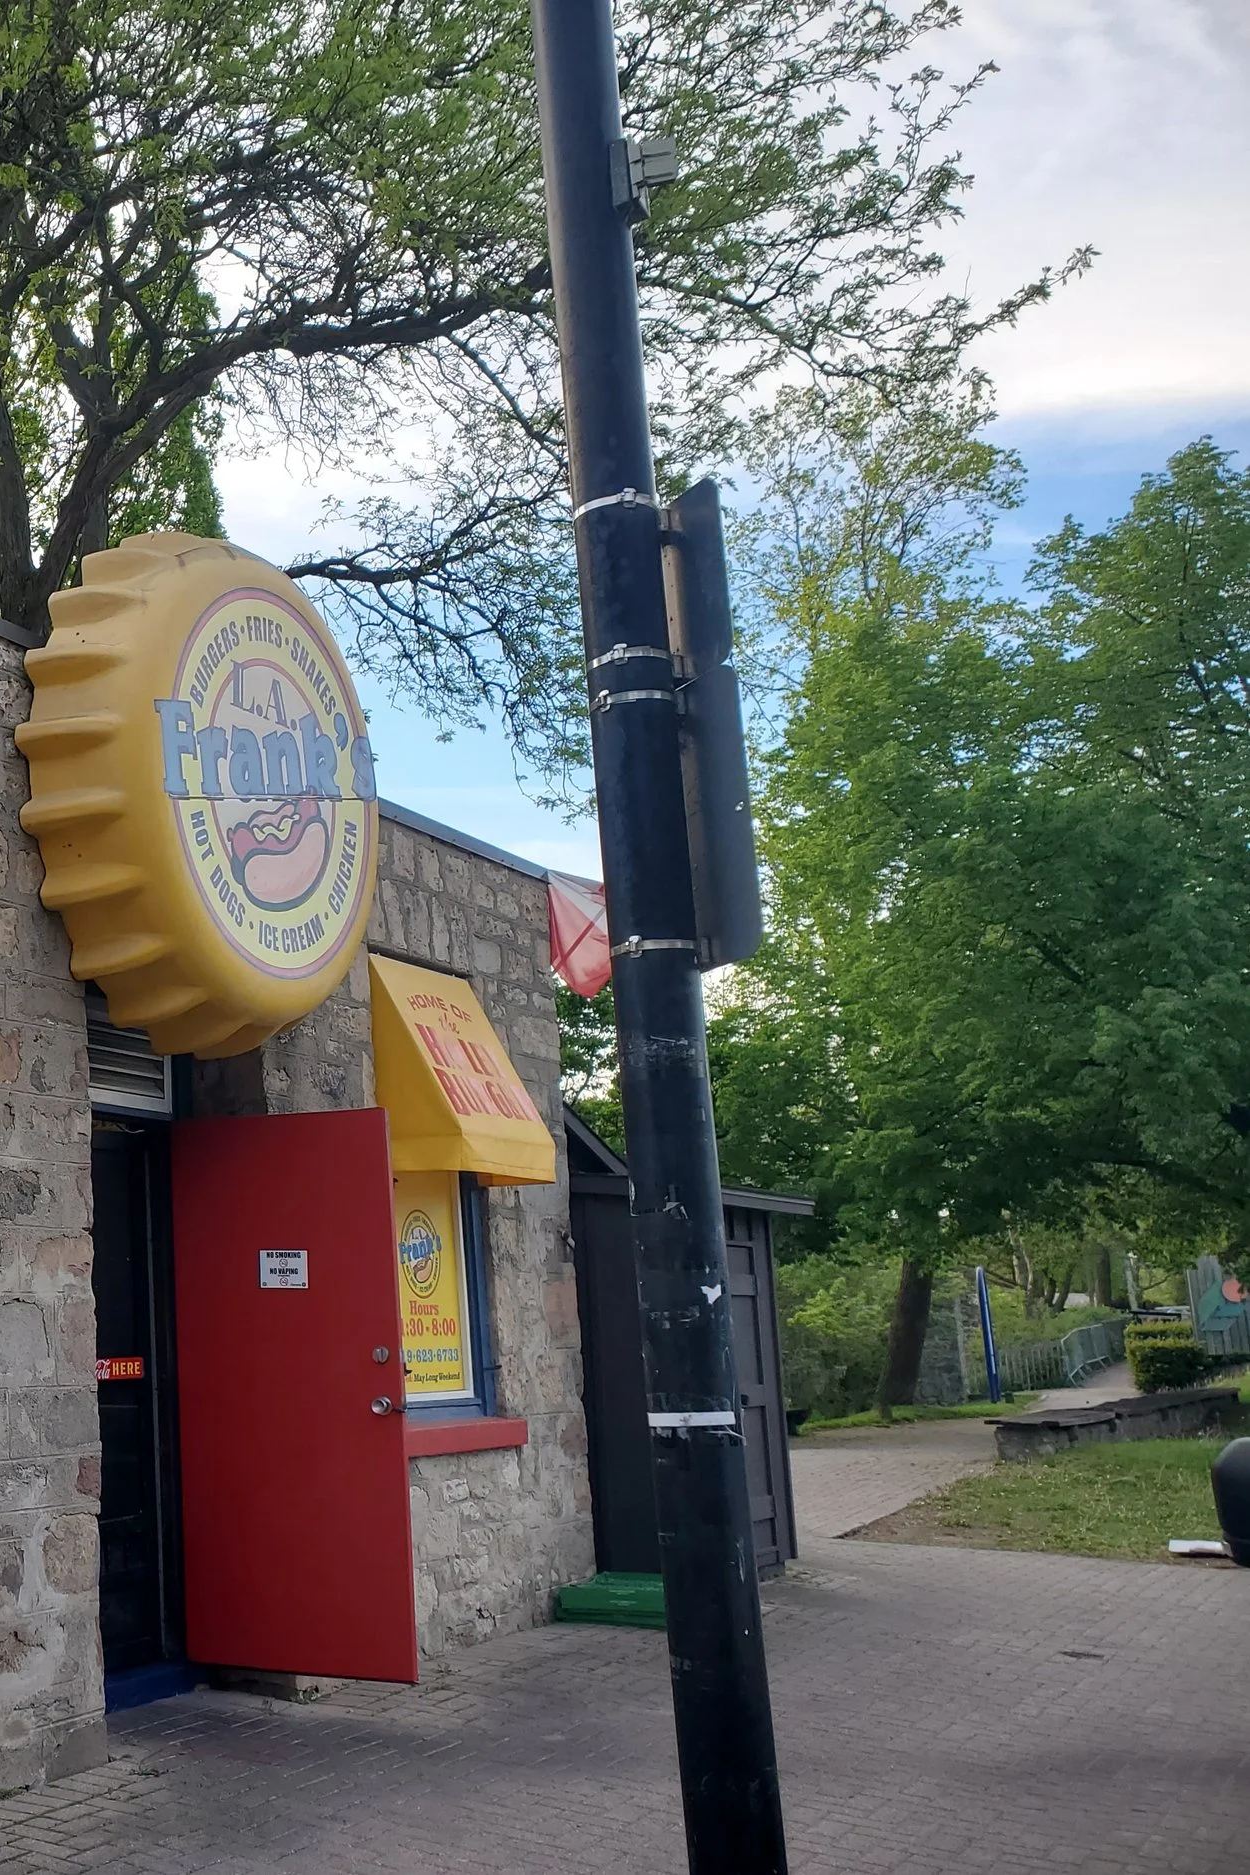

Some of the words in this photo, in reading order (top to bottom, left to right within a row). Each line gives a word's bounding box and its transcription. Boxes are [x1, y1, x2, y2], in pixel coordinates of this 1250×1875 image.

[189, 620, 240, 708] BURGERS
[246, 615, 283, 648] FRIES
[290, 637, 336, 716] SHAKES
[230, 659, 298, 731] L.A.
[154, 699, 377, 802] Frank's
[190, 809, 214, 862] HOT
[210, 865, 245, 928] DOGS
[258, 919, 280, 952] ICE
[281, 913, 325, 954] CREAM
[328, 819, 358, 916] CHICKEN
[407, 994, 448, 1012] HOME
[450, 1003, 472, 1023] OF
[266, 1251, 274, 1259] NO
[275, 1251, 302, 1259] SMOKING
[269, 1267, 277, 1275] NO
[278, 1267, 299, 1275] VAPING
[409, 1300, 439, 1315] Hours
[432, 1317, 456, 1337] 8:00
[112, 1361, 141, 1376] HERE
[414, 1373, 425, 1384] May
[426, 1372, 438, 1383] Long
